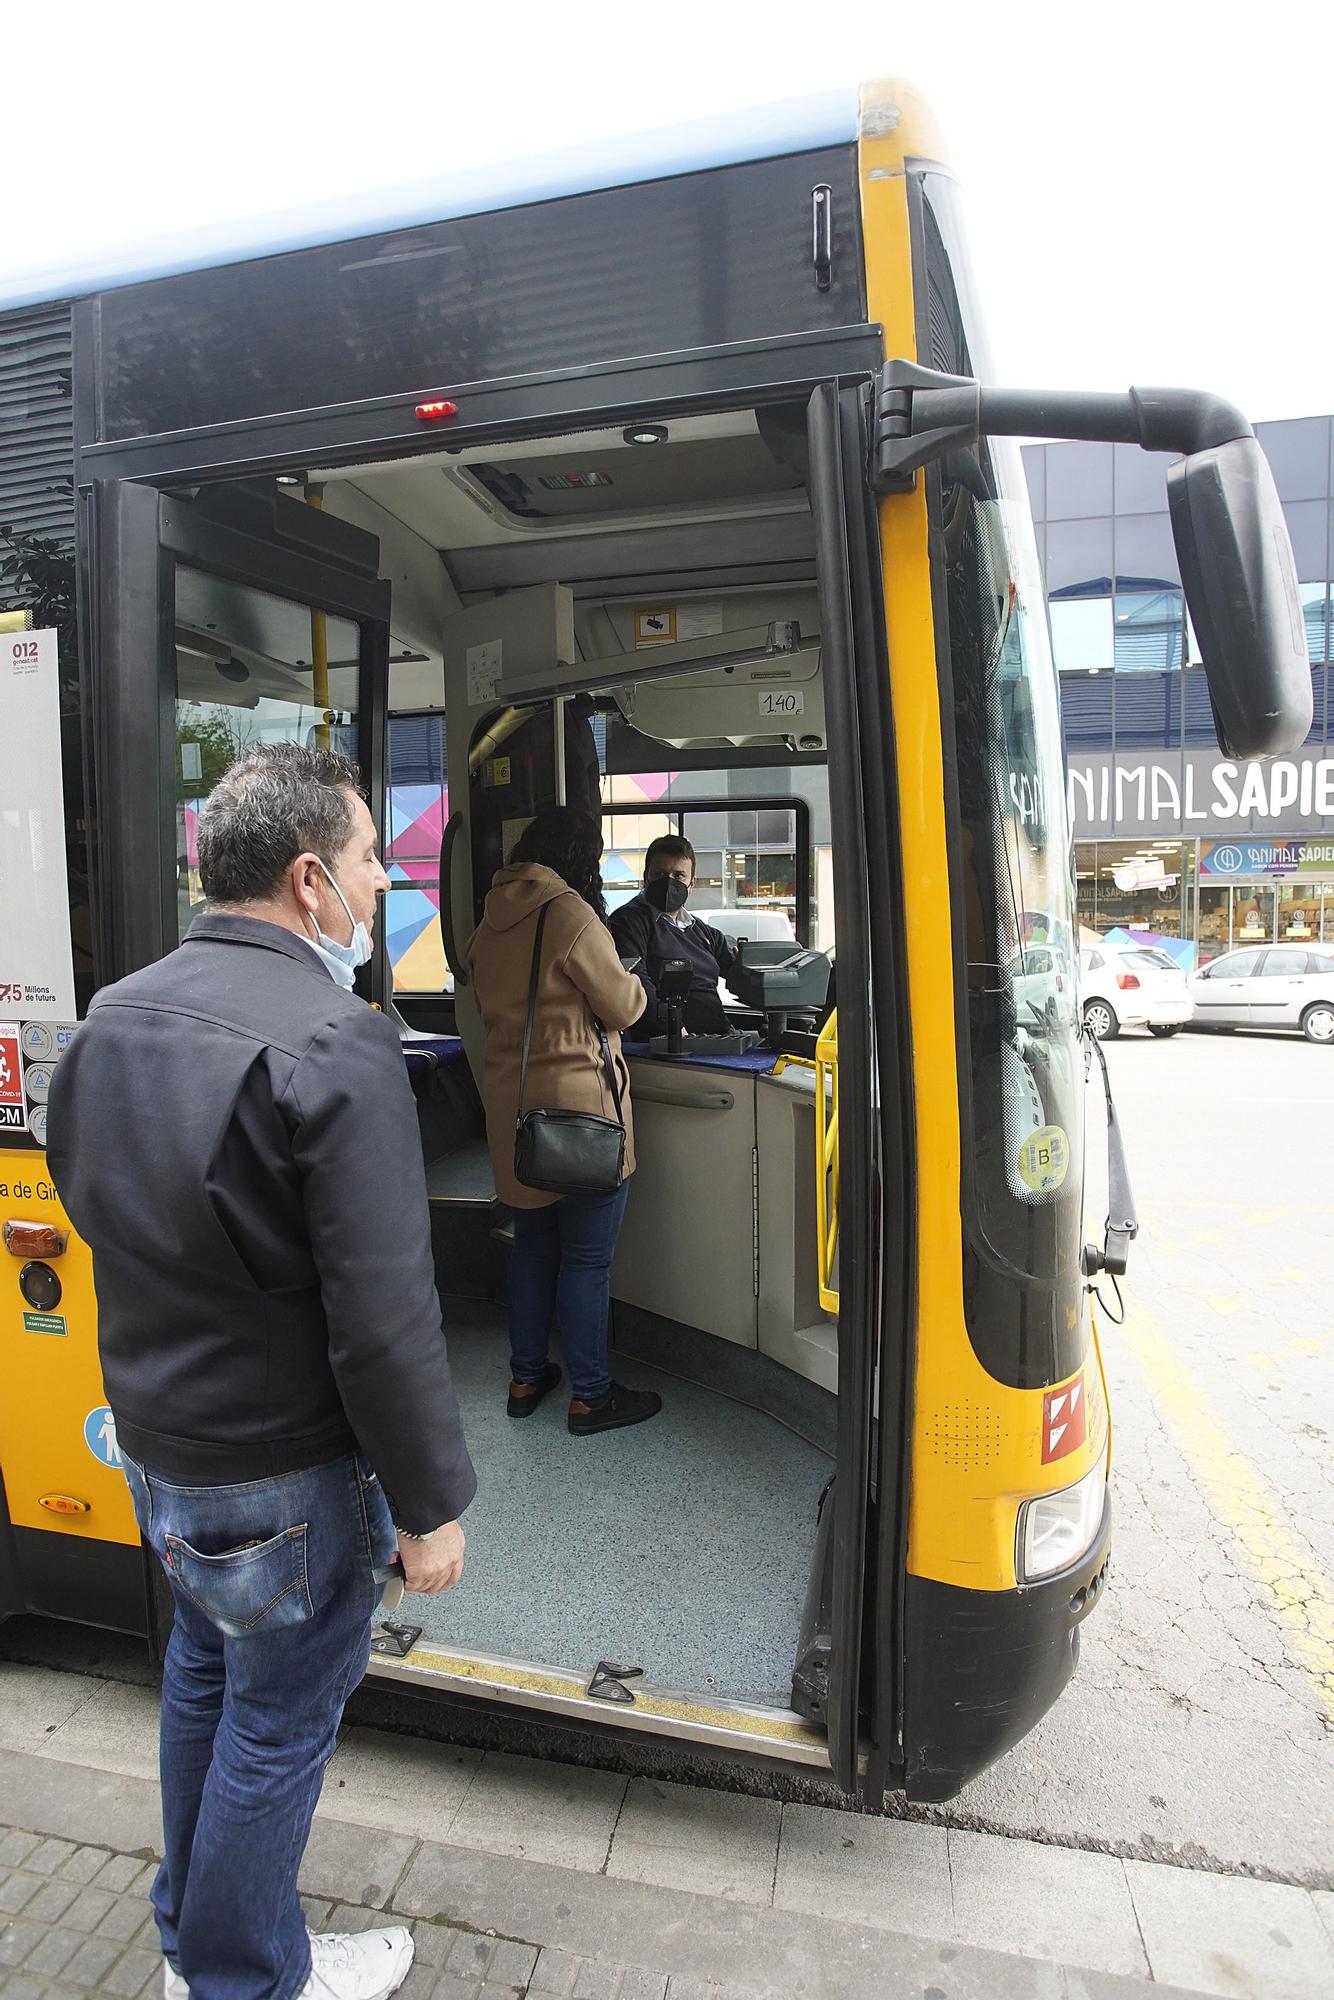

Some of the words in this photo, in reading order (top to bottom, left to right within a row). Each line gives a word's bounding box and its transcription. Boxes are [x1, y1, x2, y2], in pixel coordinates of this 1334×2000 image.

[13, 642, 38, 658] 012
[1039, 1149, 1049, 1165] B
[13, 1181, 32, 1198] de
